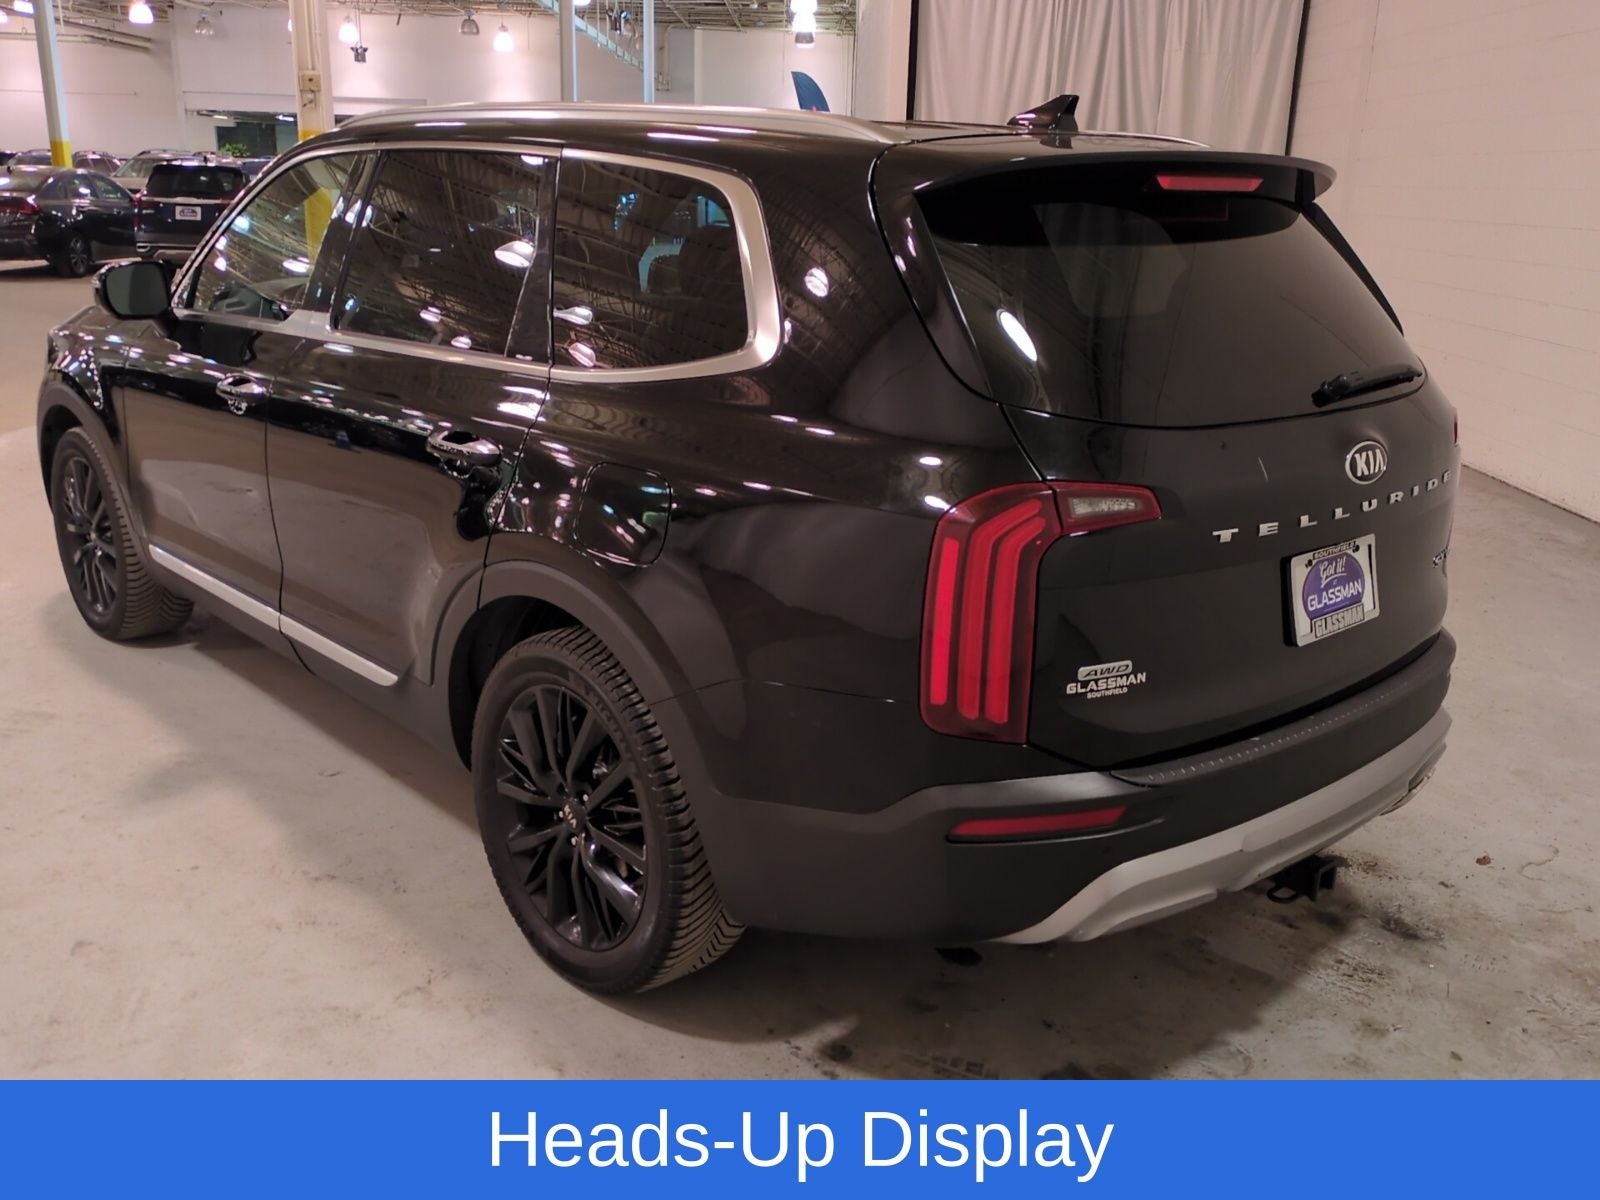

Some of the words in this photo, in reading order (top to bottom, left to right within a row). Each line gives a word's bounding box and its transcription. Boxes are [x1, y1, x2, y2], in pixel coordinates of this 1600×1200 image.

[1354, 449, 1387, 477] KIA
[1212, 470, 1452, 543] TELLURIDE
[1319, 561, 1336, 577] Got
[1307, 579, 1362, 611] GLASSMAN
[1315, 605, 1364, 637] GLASSMAN
[1066, 672, 1147, 694] GLASSMAN
[1082, 664, 1129, 679] AWD
[1086, 687, 1128, 700] SOUTHFIELD
